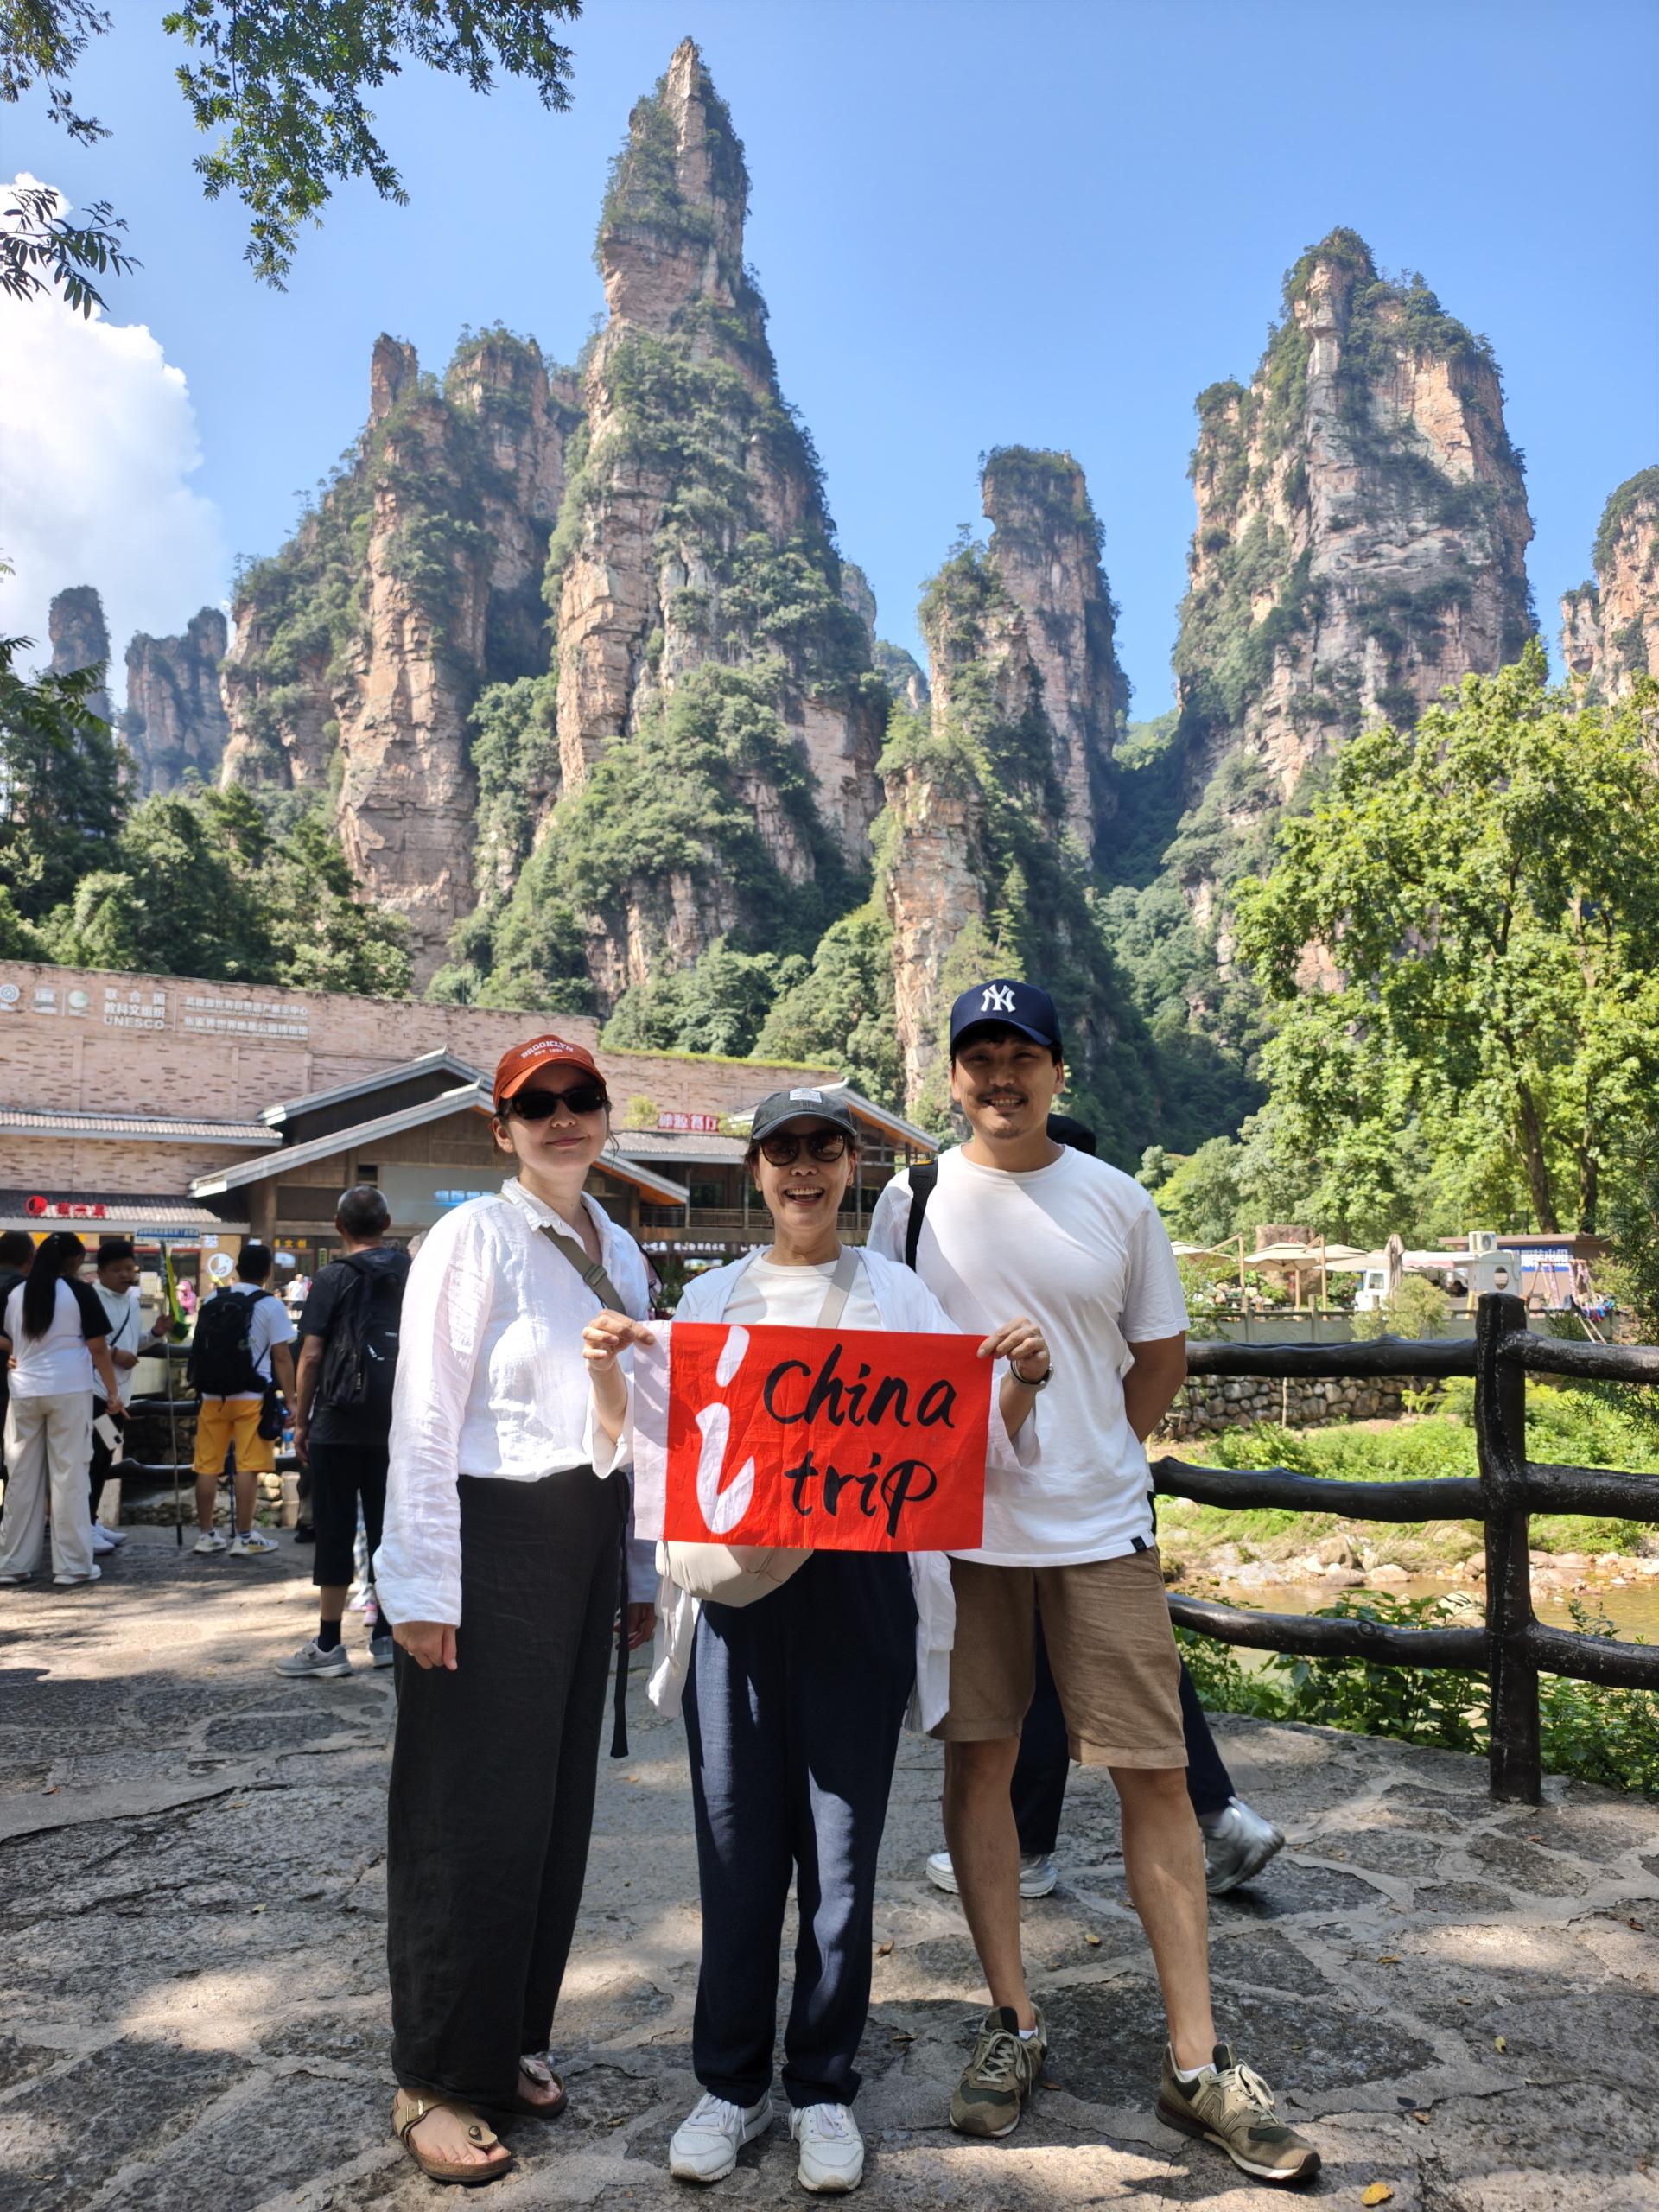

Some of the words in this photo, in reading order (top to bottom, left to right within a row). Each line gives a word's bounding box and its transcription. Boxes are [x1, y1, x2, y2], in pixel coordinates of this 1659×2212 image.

[980, 983, 1016, 1014] NY
[104, 1014, 166, 1030] UNESCO
[520, 1040, 574, 1058] BROOKLYN
[762, 1342, 957, 1429] China
[783, 1449, 938, 1539] trip
